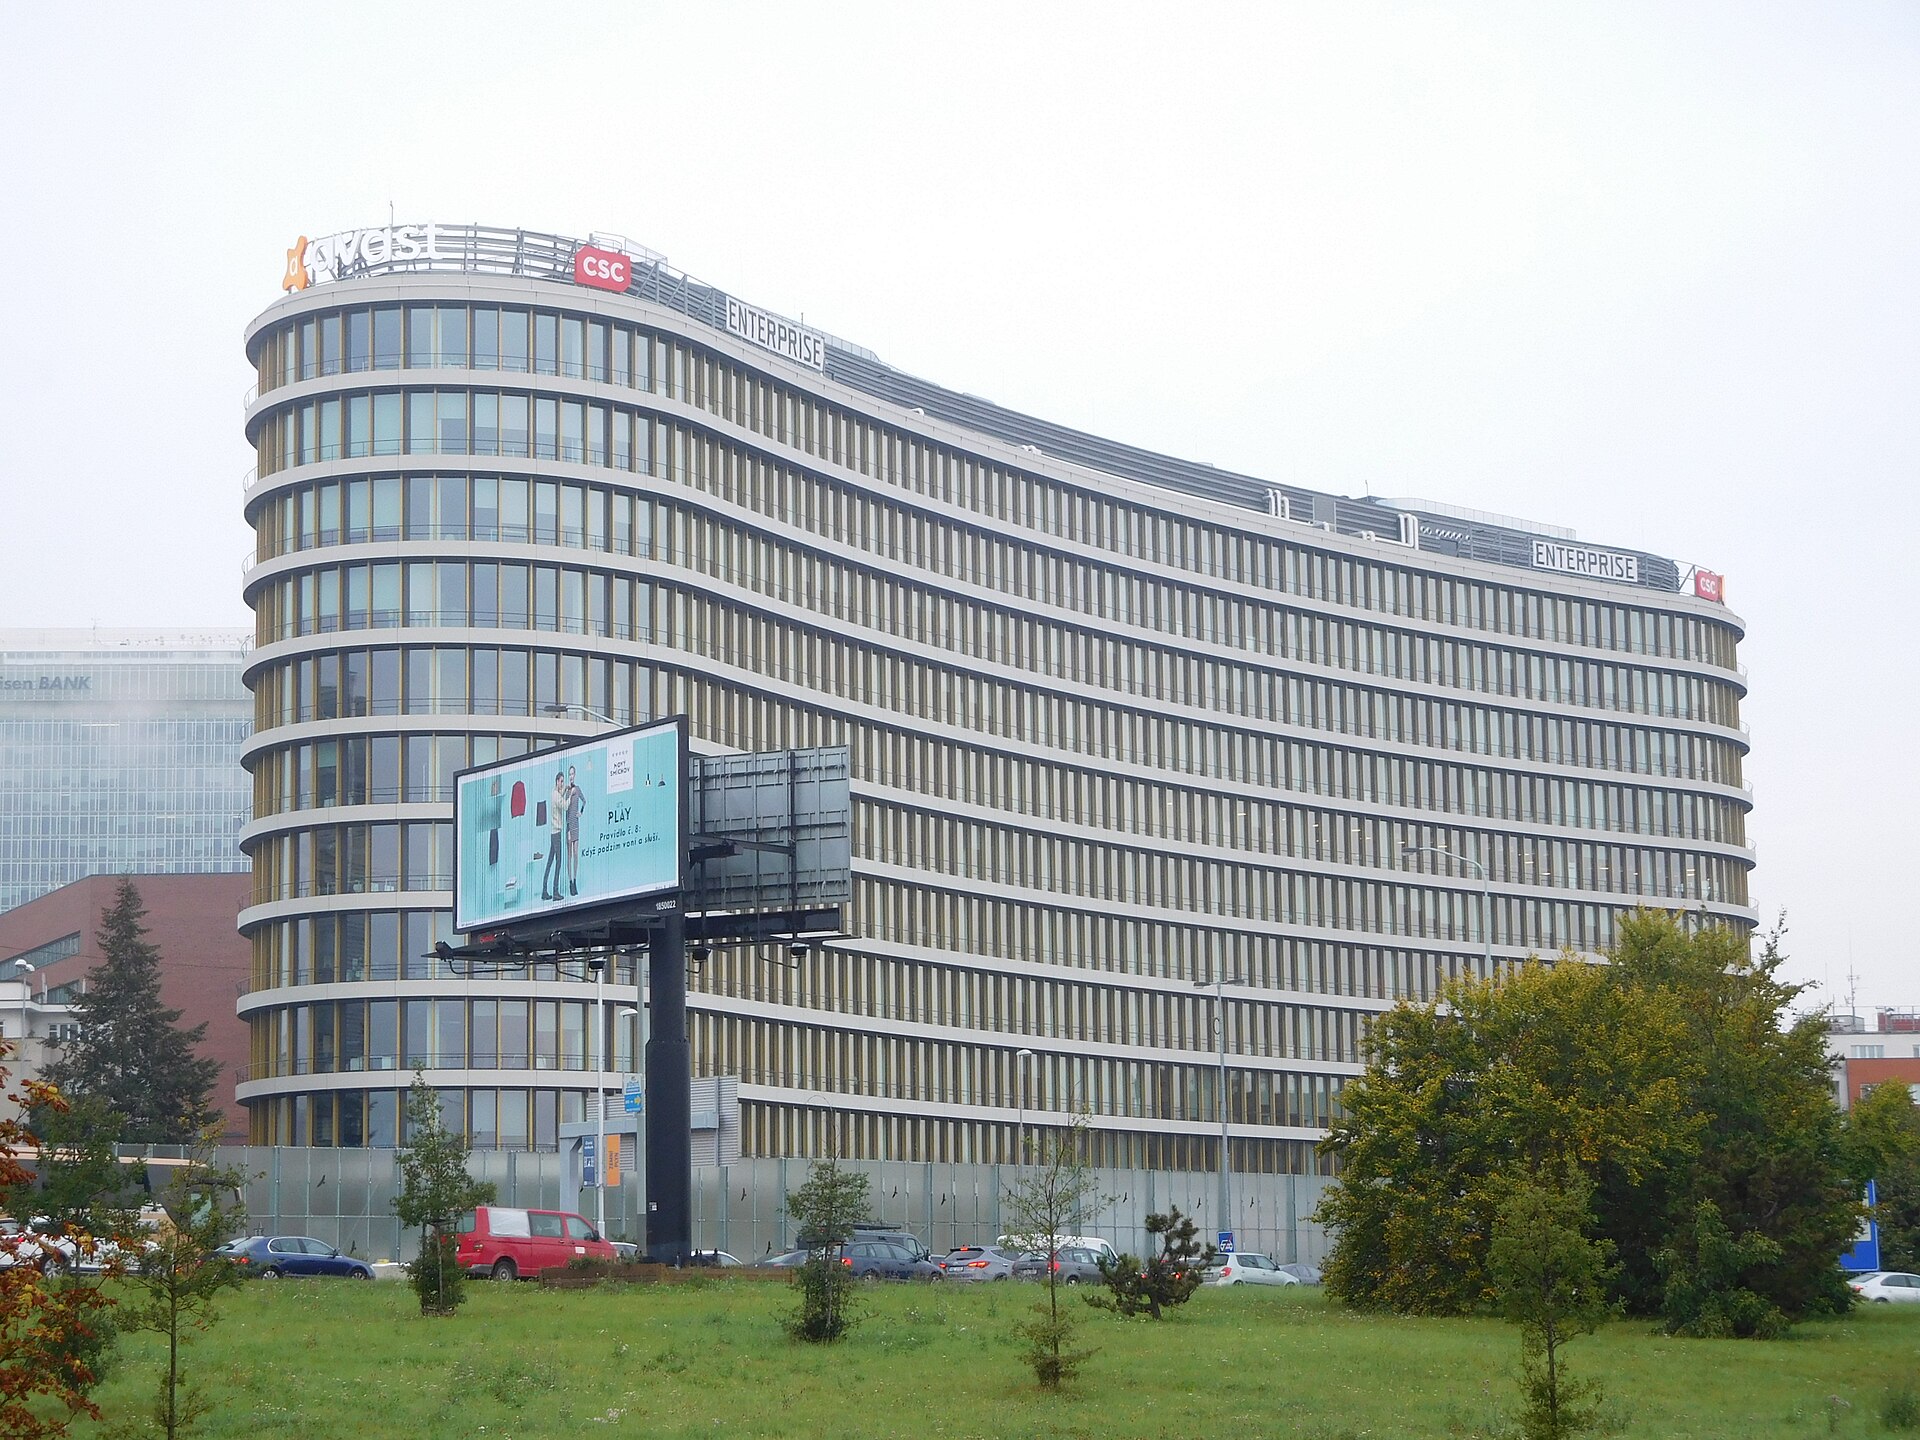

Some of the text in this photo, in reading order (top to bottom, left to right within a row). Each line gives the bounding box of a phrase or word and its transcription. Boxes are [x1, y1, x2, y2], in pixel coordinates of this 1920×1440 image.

[309, 220, 444, 272] avast
[582, 255, 625, 283] CSC
[728, 300, 823, 367] ENTERPRISE
[1535, 542, 1635, 580] ENTERPRISE
[1700, 577, 1717, 594] CSC
[39, 676, 91, 690] BANK
[608, 806, 632, 824] PLAY
[599, 828, 626, 841] Pravidlo
[581, 846, 596, 858] Když
[597, 842, 621, 856] podzim
